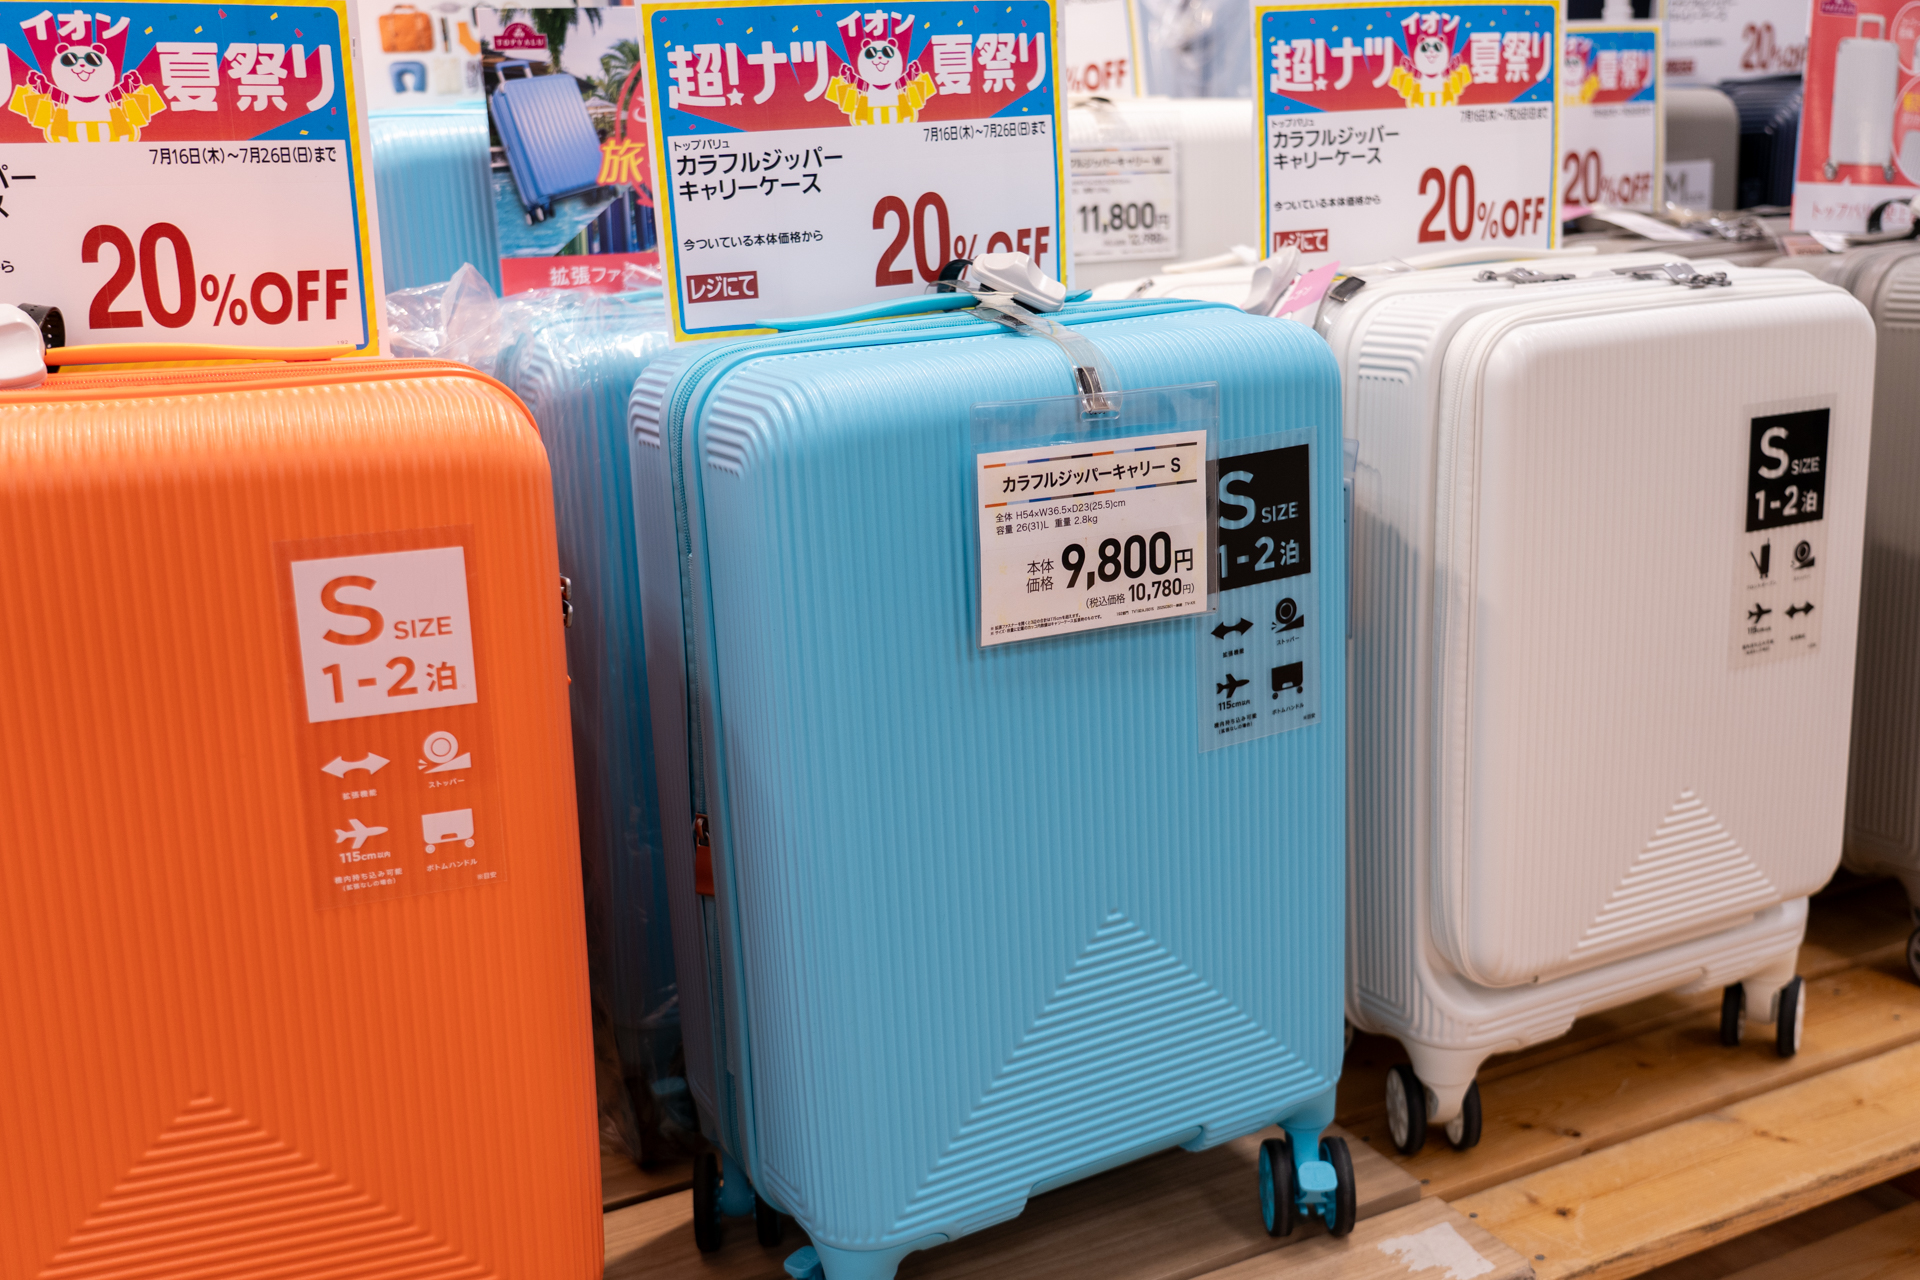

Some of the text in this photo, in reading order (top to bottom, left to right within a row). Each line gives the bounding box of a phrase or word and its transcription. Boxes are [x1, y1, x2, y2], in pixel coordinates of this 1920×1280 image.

[20, 10, 131, 41] イオン
[837, 10, 915, 36] イオン
[1401, 11, 1460, 35] イオン
[931, 32, 1046, 95] 夏祭り
[1469, 32, 1552, 84] 夏祭り
[156, 42, 335, 111] 夏祭り
[599, 139, 645, 183] 旅
[677, 147, 843, 177] カラフルジッパー
[1273, 147, 1382, 170] キャリーケース
[679, 173, 822, 201] キャリーケース
[684, 230, 823, 251] 今ついている本体価格から
[690, 274, 755, 298] レジにて
[1758, 426, 1820, 479] S SIZE
[1002, 457, 1181, 493] カラフルジッパーキャリー S
[1218, 470, 1299, 530] S SIZE
[1754, 485, 1818, 520] 1-2泊
[995, 512, 1013, 523] 全体
[996, 515, 1098, 535] 容量 26(31)L 重量 2.8kg
[1026, 558, 1054, 575] 本体
[1061, 531, 1193, 591] 9,800円
[1026, 575, 1054, 594] 価格
[1085, 577, 1195, 608] (税込価格 10,780円)
[320, 575, 453, 646] S SIZE
[1222, 648, 1245, 658] 拡張機能
[1276, 635, 1300, 647] ストッパー
[322, 656, 458, 704] 1-2泊
[1272, 703, 1305, 716] ボトムハンドル
[342, 789, 378, 801] 拡張機能
[428, 777, 465, 789] ストッパー
[339, 850, 391, 864] 115cm以内
[426, 858, 478, 872] ボトムハンドル
[334, 867, 403, 885] 機内持ち込み可能
